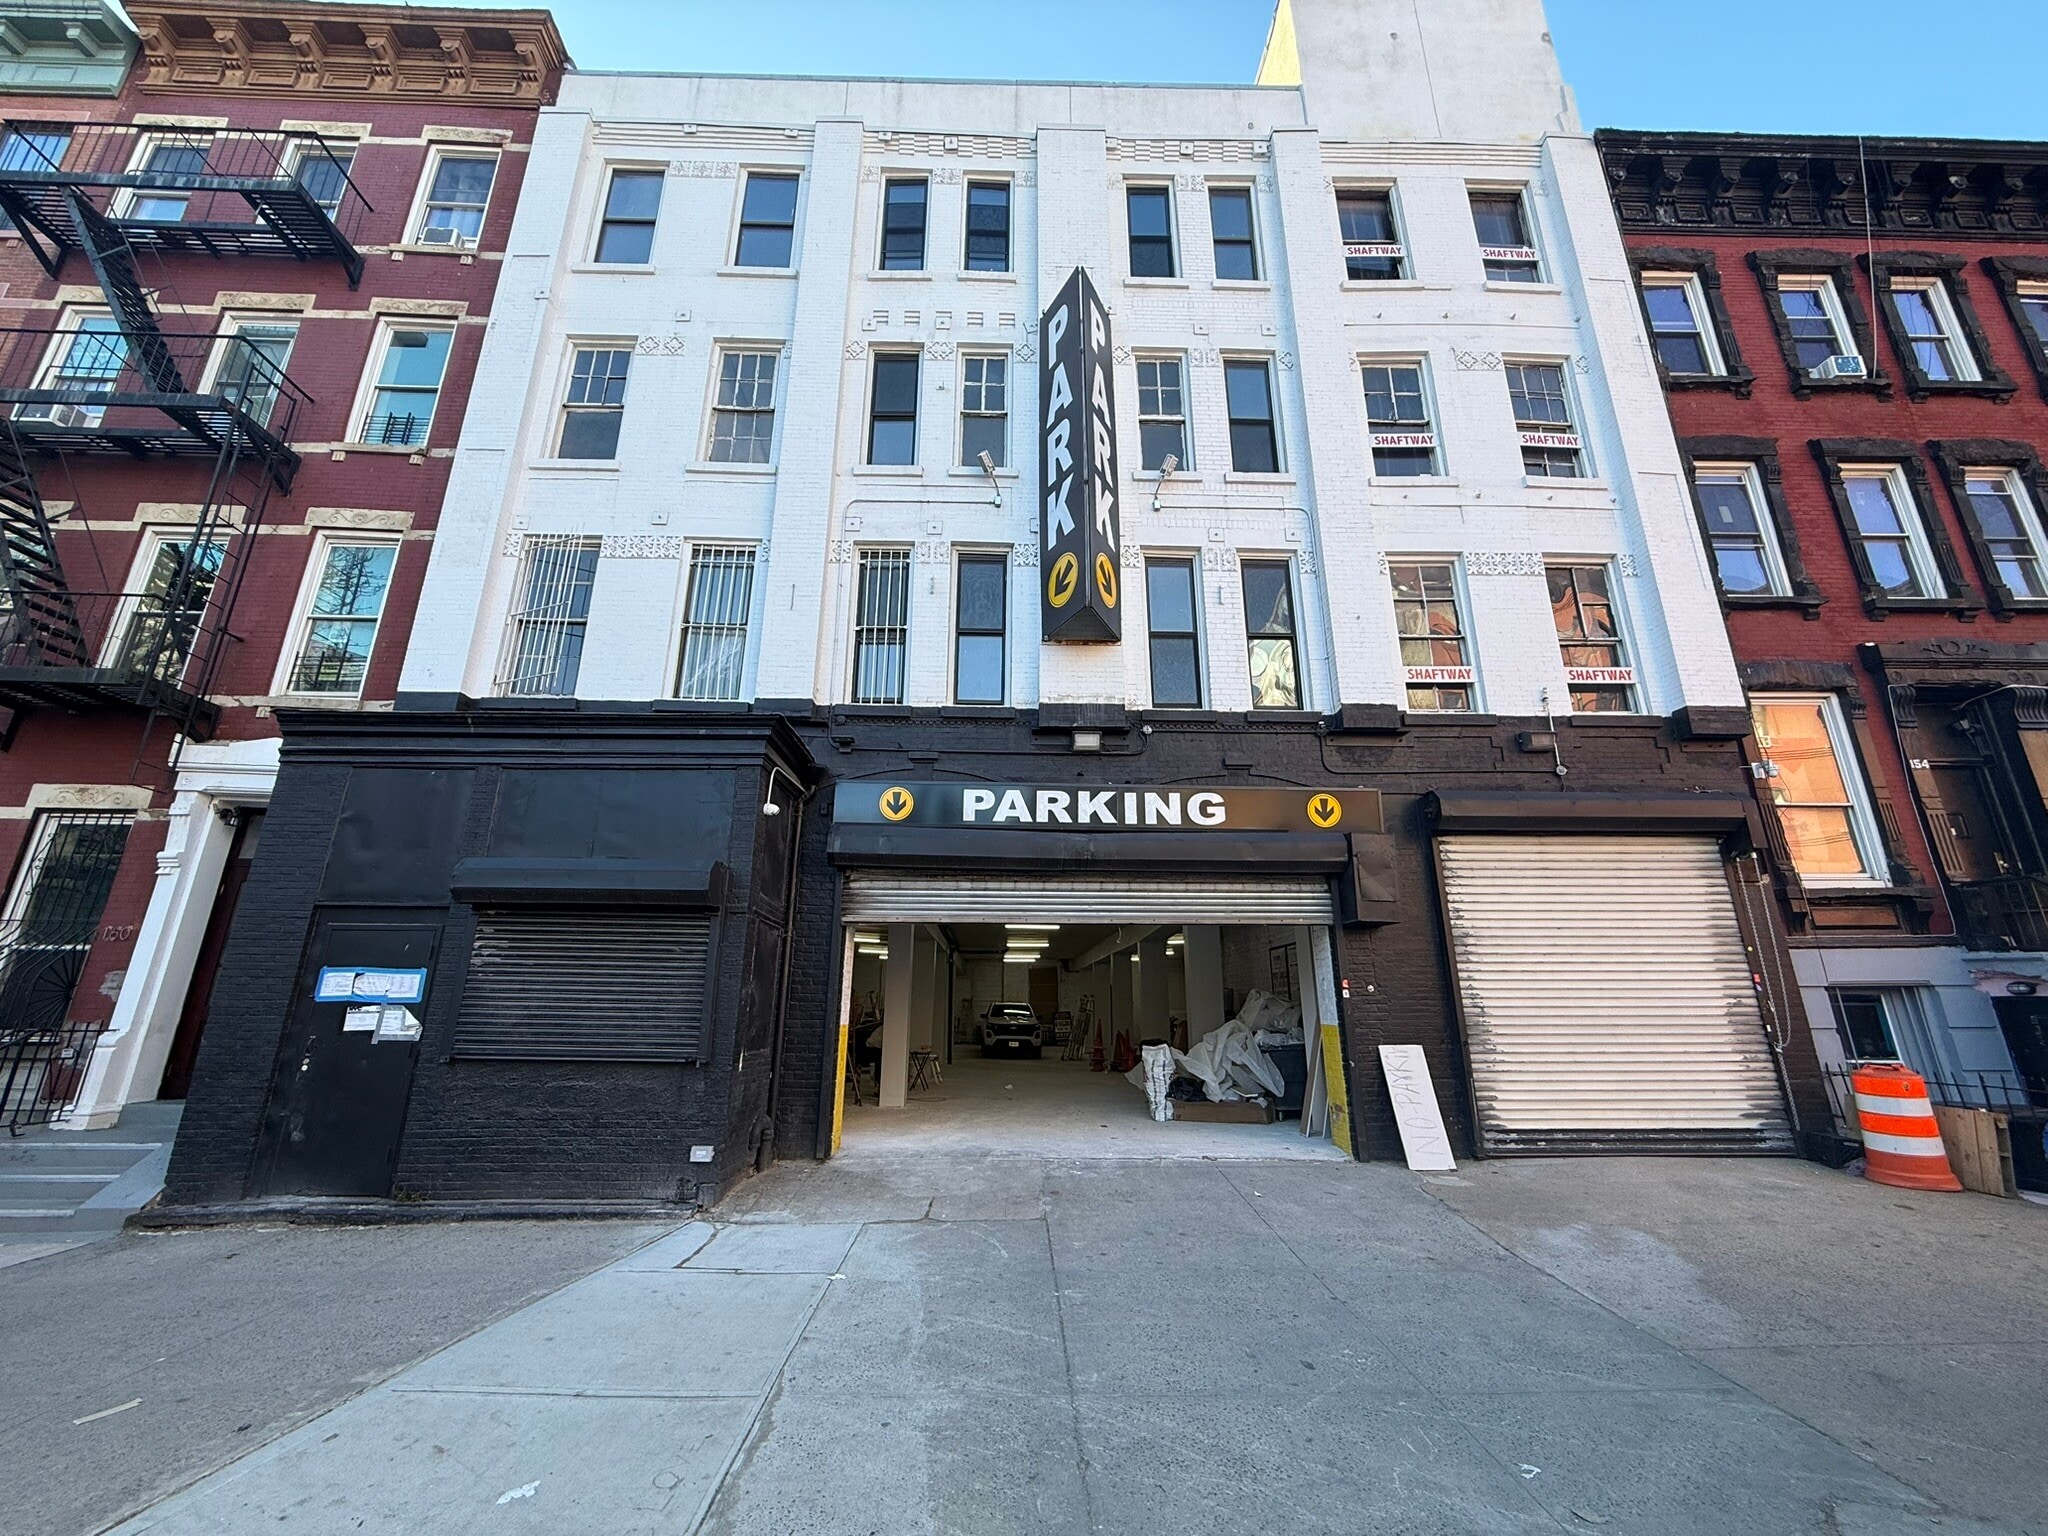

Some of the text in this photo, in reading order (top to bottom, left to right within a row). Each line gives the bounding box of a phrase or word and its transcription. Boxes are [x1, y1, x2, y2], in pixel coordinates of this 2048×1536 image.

[1347, 246, 1402, 256] SHAFTWAY
[1482, 248, 1536, 260] SHAFTWAY
[1046, 303, 1076, 552] PARK
[1089, 297, 1116, 552] PARK
[1374, 435, 1434, 446] SHAFTWAY
[1522, 433, 1579, 447] SHAFTWAY
[1407, 668, 1472, 681] SHAFTWAY
[1568, 669, 1633, 682] SHAFTWAY
[1909, 759, 1930, 769] 154
[962, 788, 1227, 826] PARKING
